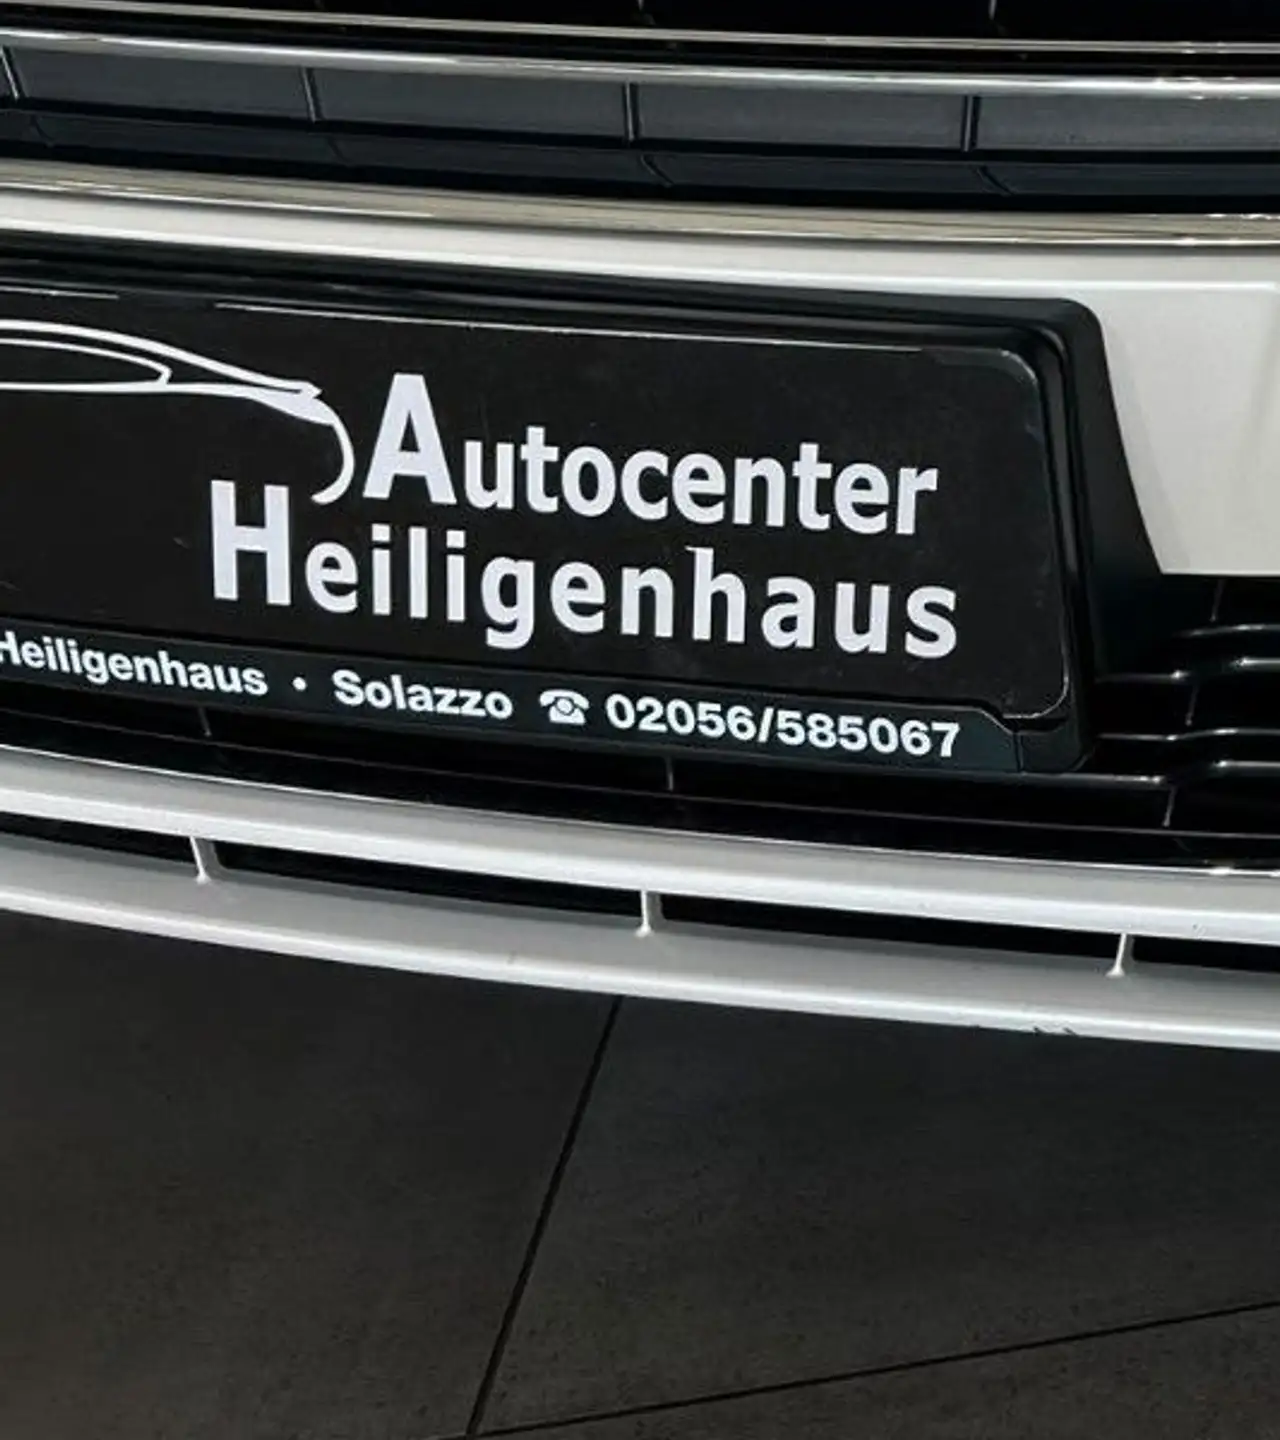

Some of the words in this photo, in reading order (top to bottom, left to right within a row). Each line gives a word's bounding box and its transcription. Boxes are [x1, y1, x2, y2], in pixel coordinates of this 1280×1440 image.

[362, 371, 939, 536] Autocenter
[210, 478, 958, 659] Heiligenhaus
[0, 629, 269, 696] Heiligenhaus
[332, 668, 513, 720] Solazzo
[604, 692, 961, 758] 02056/585067
